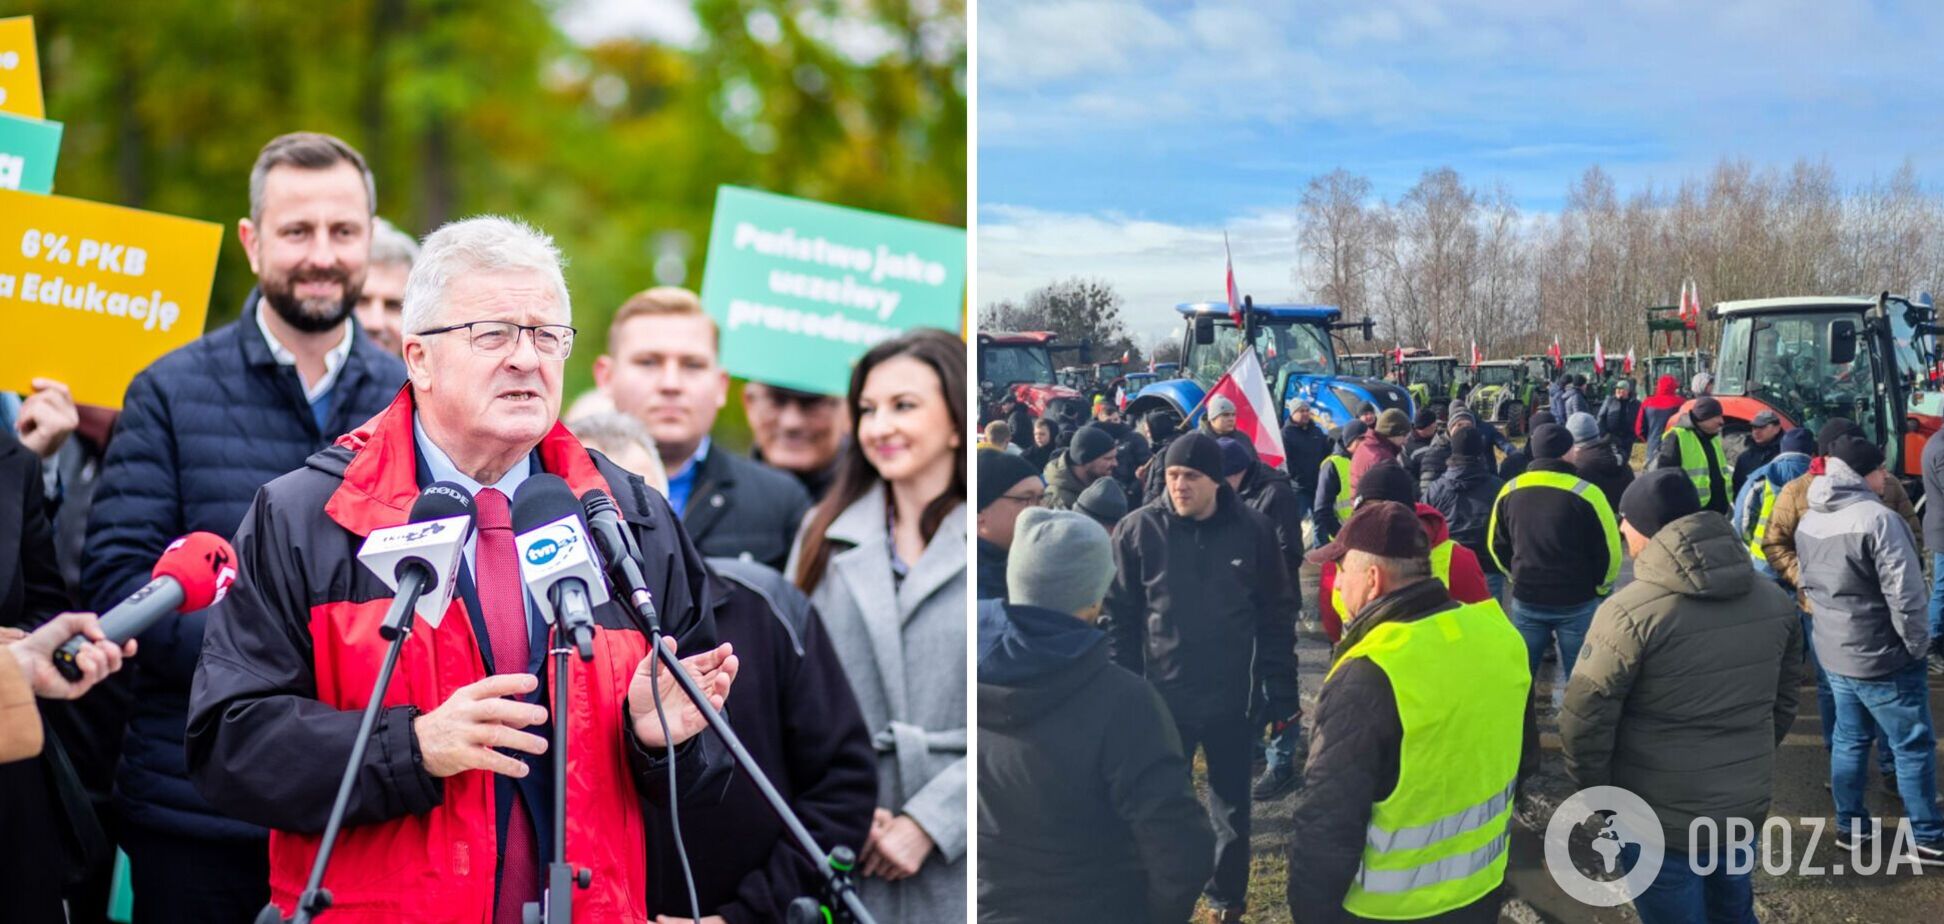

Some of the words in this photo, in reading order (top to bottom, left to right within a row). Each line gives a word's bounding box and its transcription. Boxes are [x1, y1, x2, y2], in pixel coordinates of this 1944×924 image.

[20, 228, 72, 265] 6%
[77, 238, 148, 278] PKB
[733, 222, 873, 272] Państwo
[871, 244, 947, 285] jako
[20, 272, 181, 333] Edukację
[423, 486, 470, 508] RØDE
